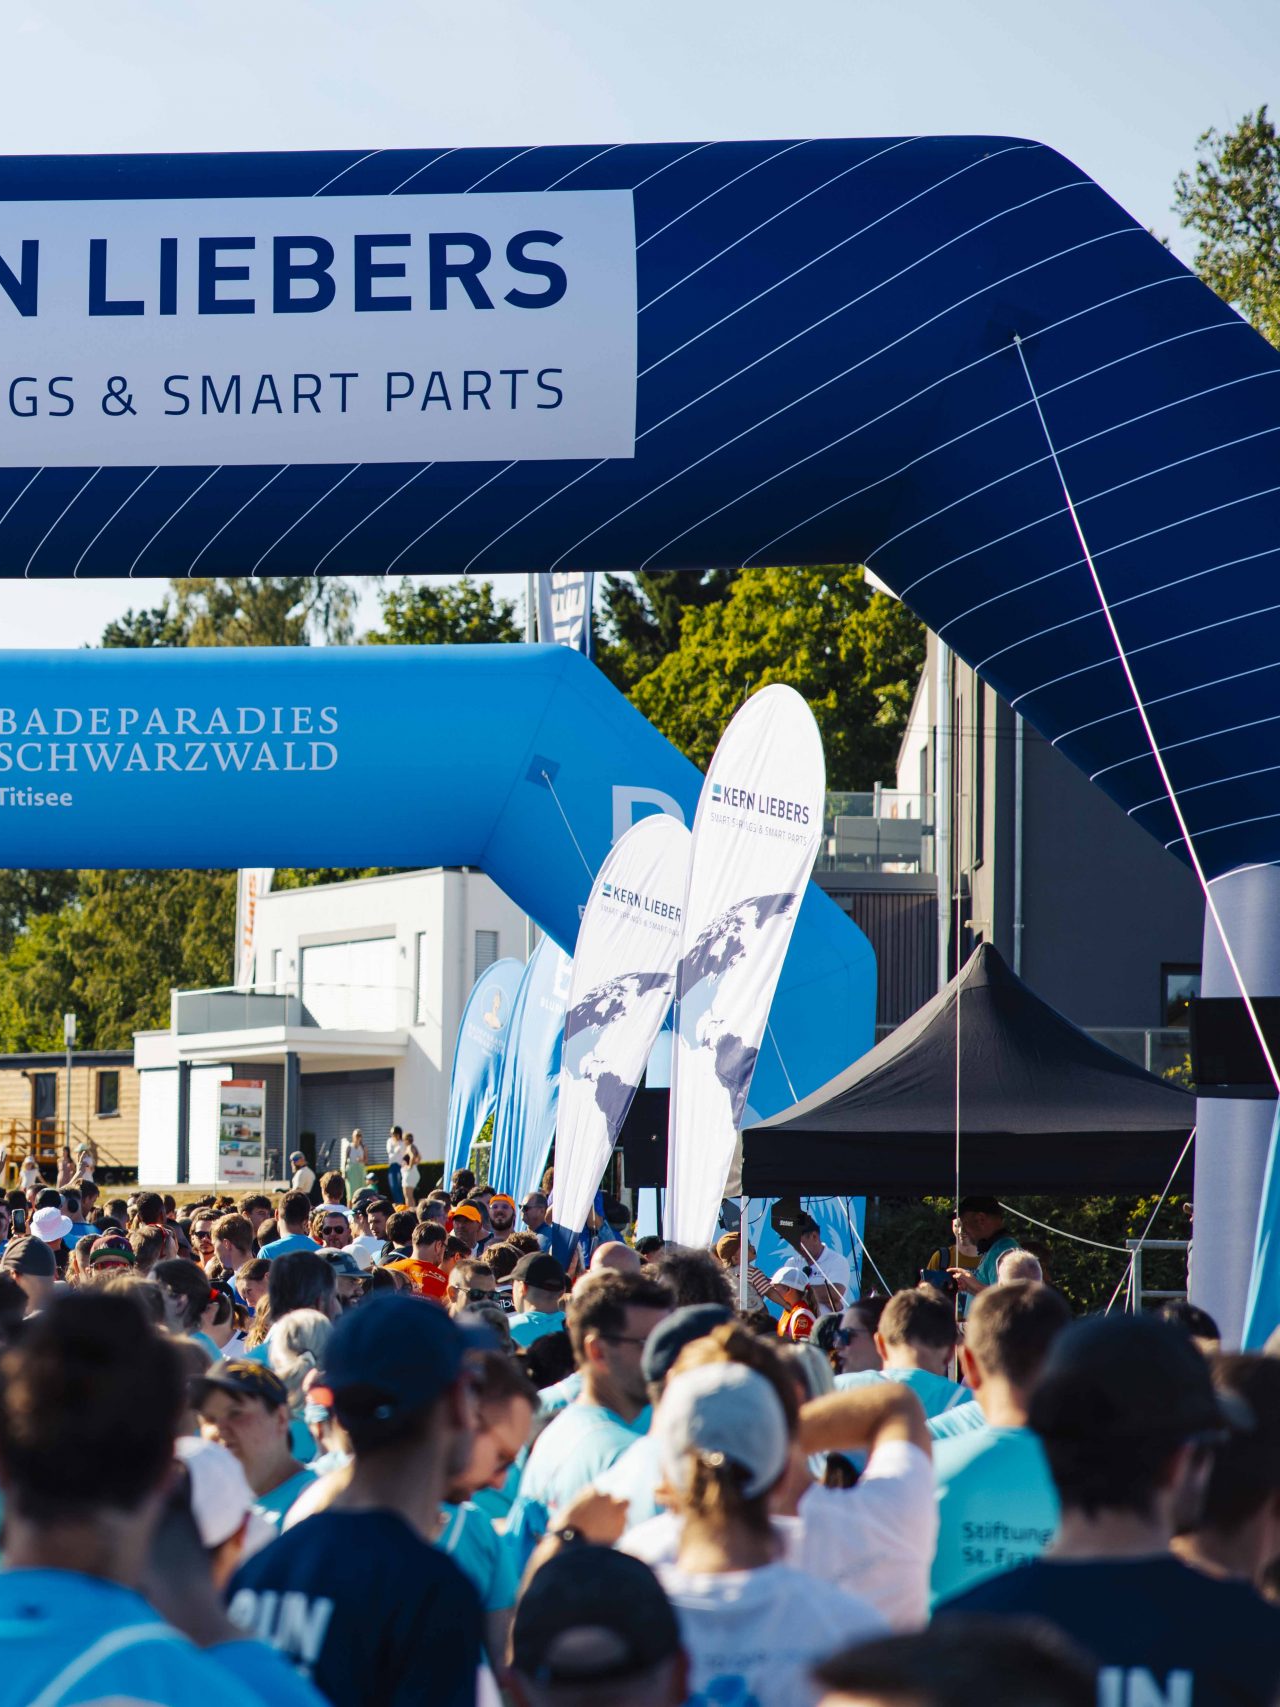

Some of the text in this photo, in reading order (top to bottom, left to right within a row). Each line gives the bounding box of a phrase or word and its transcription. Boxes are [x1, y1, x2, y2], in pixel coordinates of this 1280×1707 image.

[89, 229, 568, 317] LIEBERS
[102, 374, 138, 416] &
[164, 371, 359, 416] SMART
[384, 366, 565, 413] PARTS
[723, 786, 809, 825] KERN LIEBERS
[613, 886, 642, 908] KERN
[962, 1520, 1053, 1546] Stiftung
